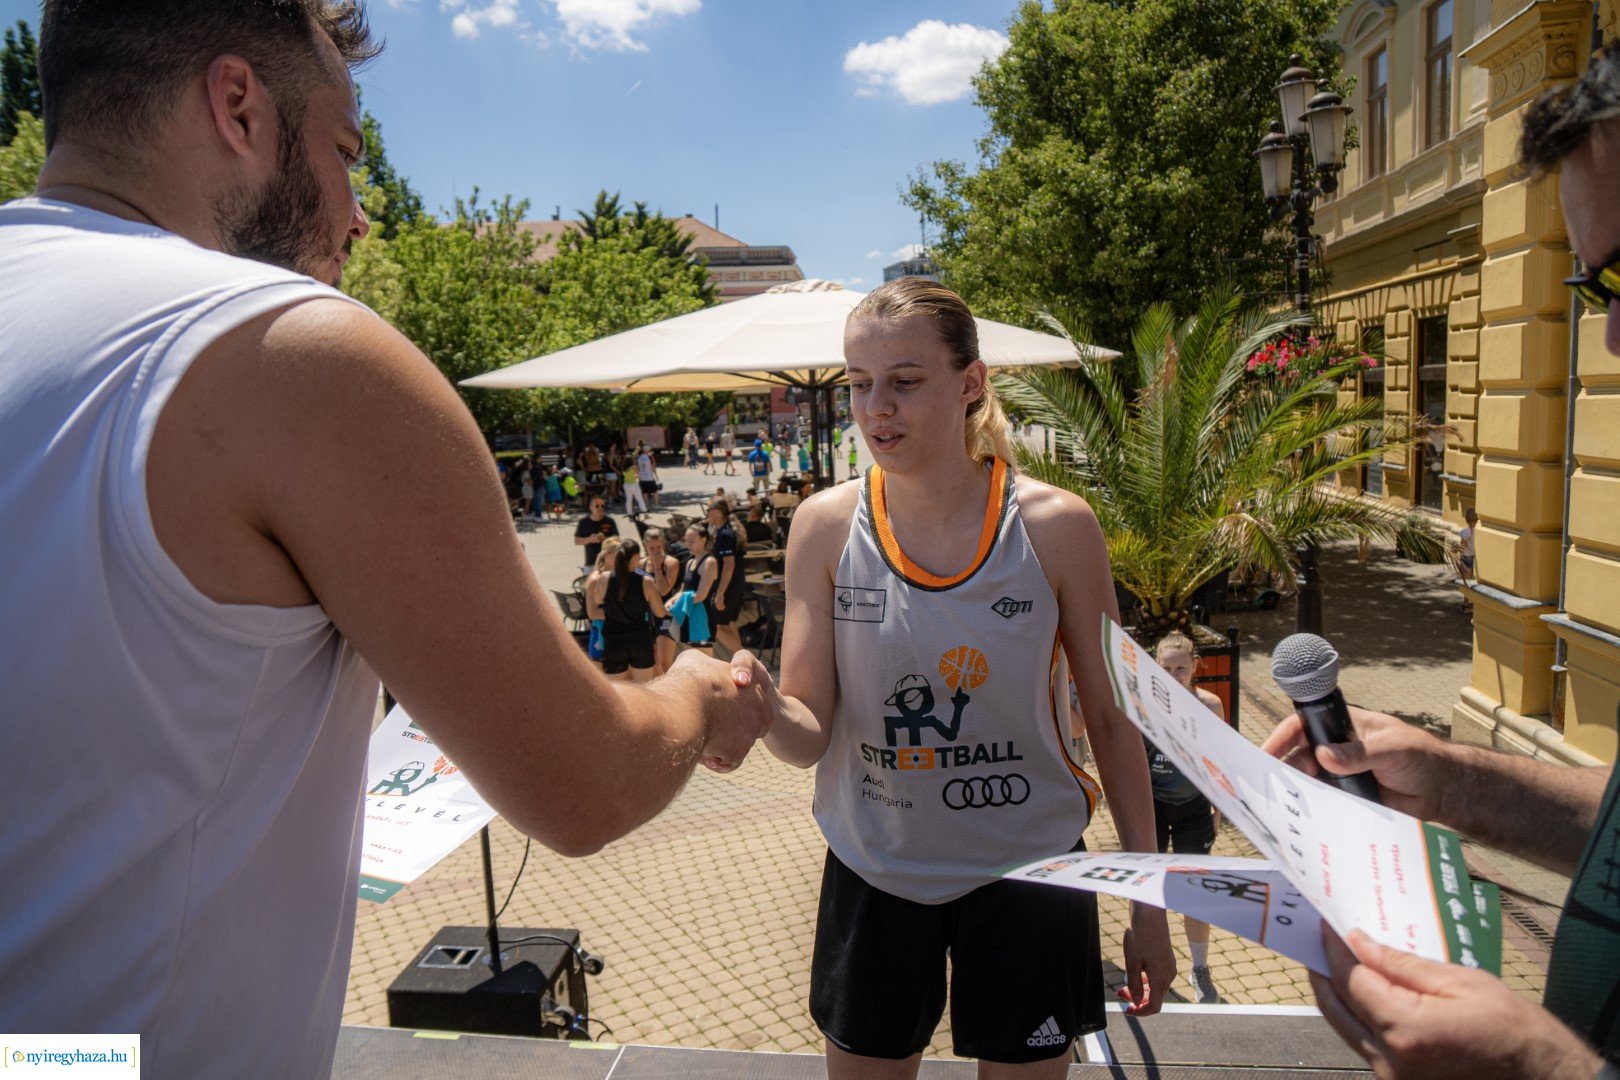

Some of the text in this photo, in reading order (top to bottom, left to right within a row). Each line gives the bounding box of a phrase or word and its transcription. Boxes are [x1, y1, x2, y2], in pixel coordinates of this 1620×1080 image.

[860, 741, 1024, 771] STREETBALL
[862, 773, 885, 790] Audi
[862, 787, 913, 809] Hungaria
[1027, 1034, 1066, 1047] adidas
